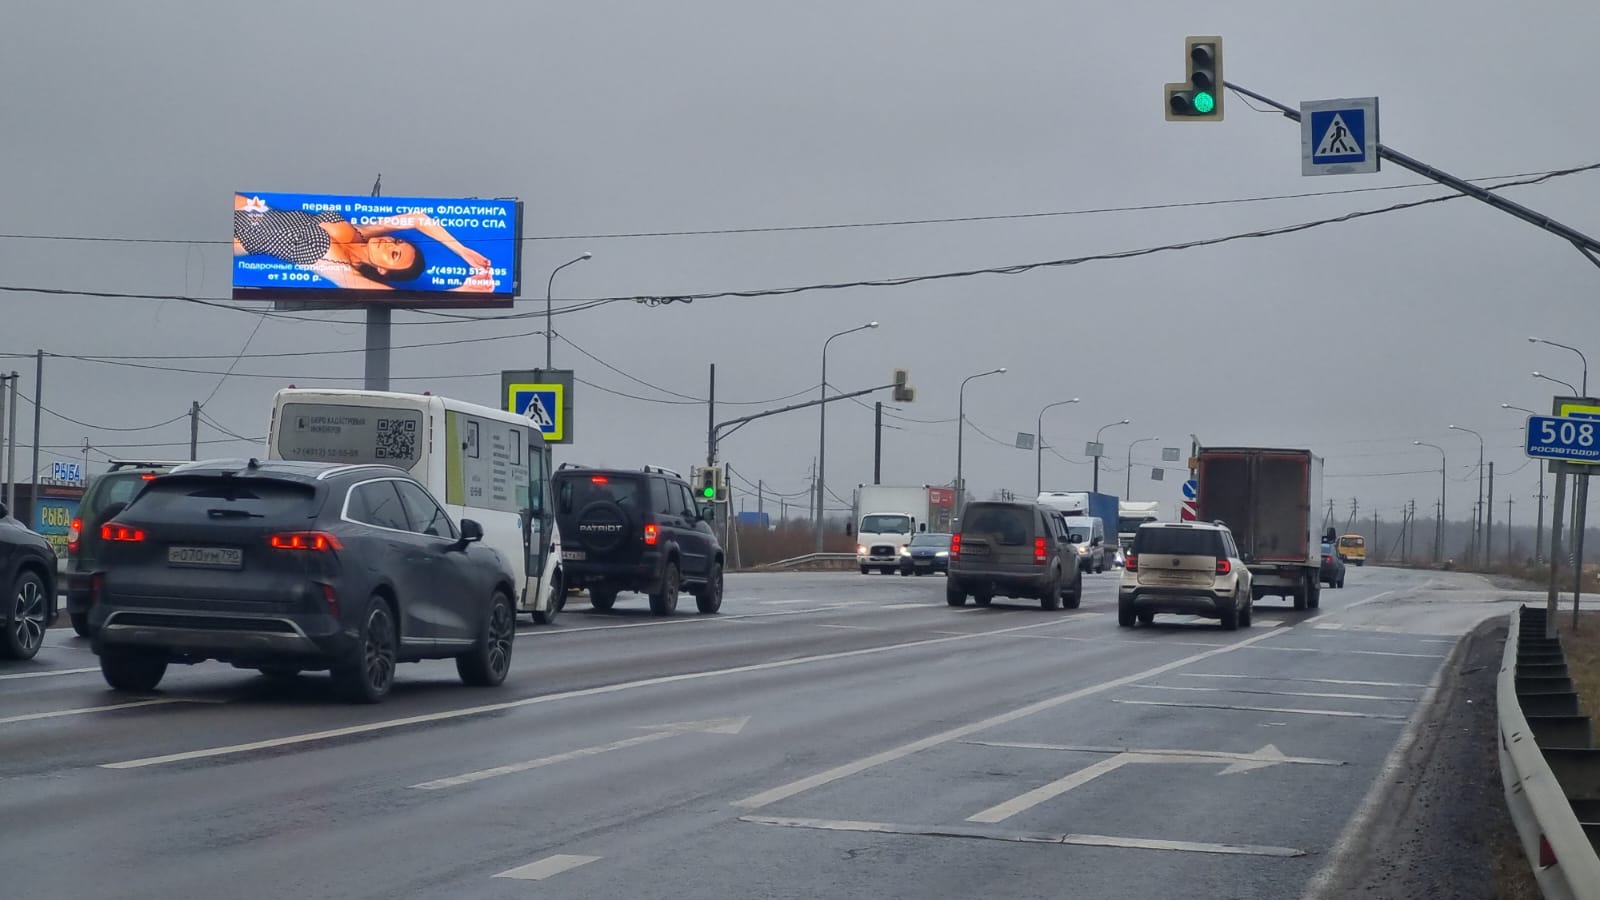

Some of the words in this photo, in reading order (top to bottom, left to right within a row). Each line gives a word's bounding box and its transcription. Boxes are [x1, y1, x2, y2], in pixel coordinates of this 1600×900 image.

[302, 202, 342, 212] первая
[344, 203, 352, 212] в
[354, 203, 393, 213] Рязани
[395, 206, 434, 215] студия
[436, 205, 507, 216] ФЛОАТИНГА
[350, 217, 357, 225] в
[360, 215, 415, 226] ОСТРОВЕ
[417, 215, 479, 228] ТАЙСКОГО
[481, 219, 506, 229] СПА
[238, 260, 293, 271] Подарочные
[435, 266, 466, 276] (4912)
[281, 272, 288, 281] 3
[289, 273, 310, 281] 000
[312, 274, 322, 282] р.
[432, 276, 445, 285] На
[447, 278, 462, 286] пл.
[1540, 420, 1594, 447] 508
[1530, 446, 1600, 457] РОСАВТОДОР
[54, 462, 80, 481] РЫБА
[41, 506, 70, 527] РЫБА
[579, 524, 623, 532] PATRIOT
